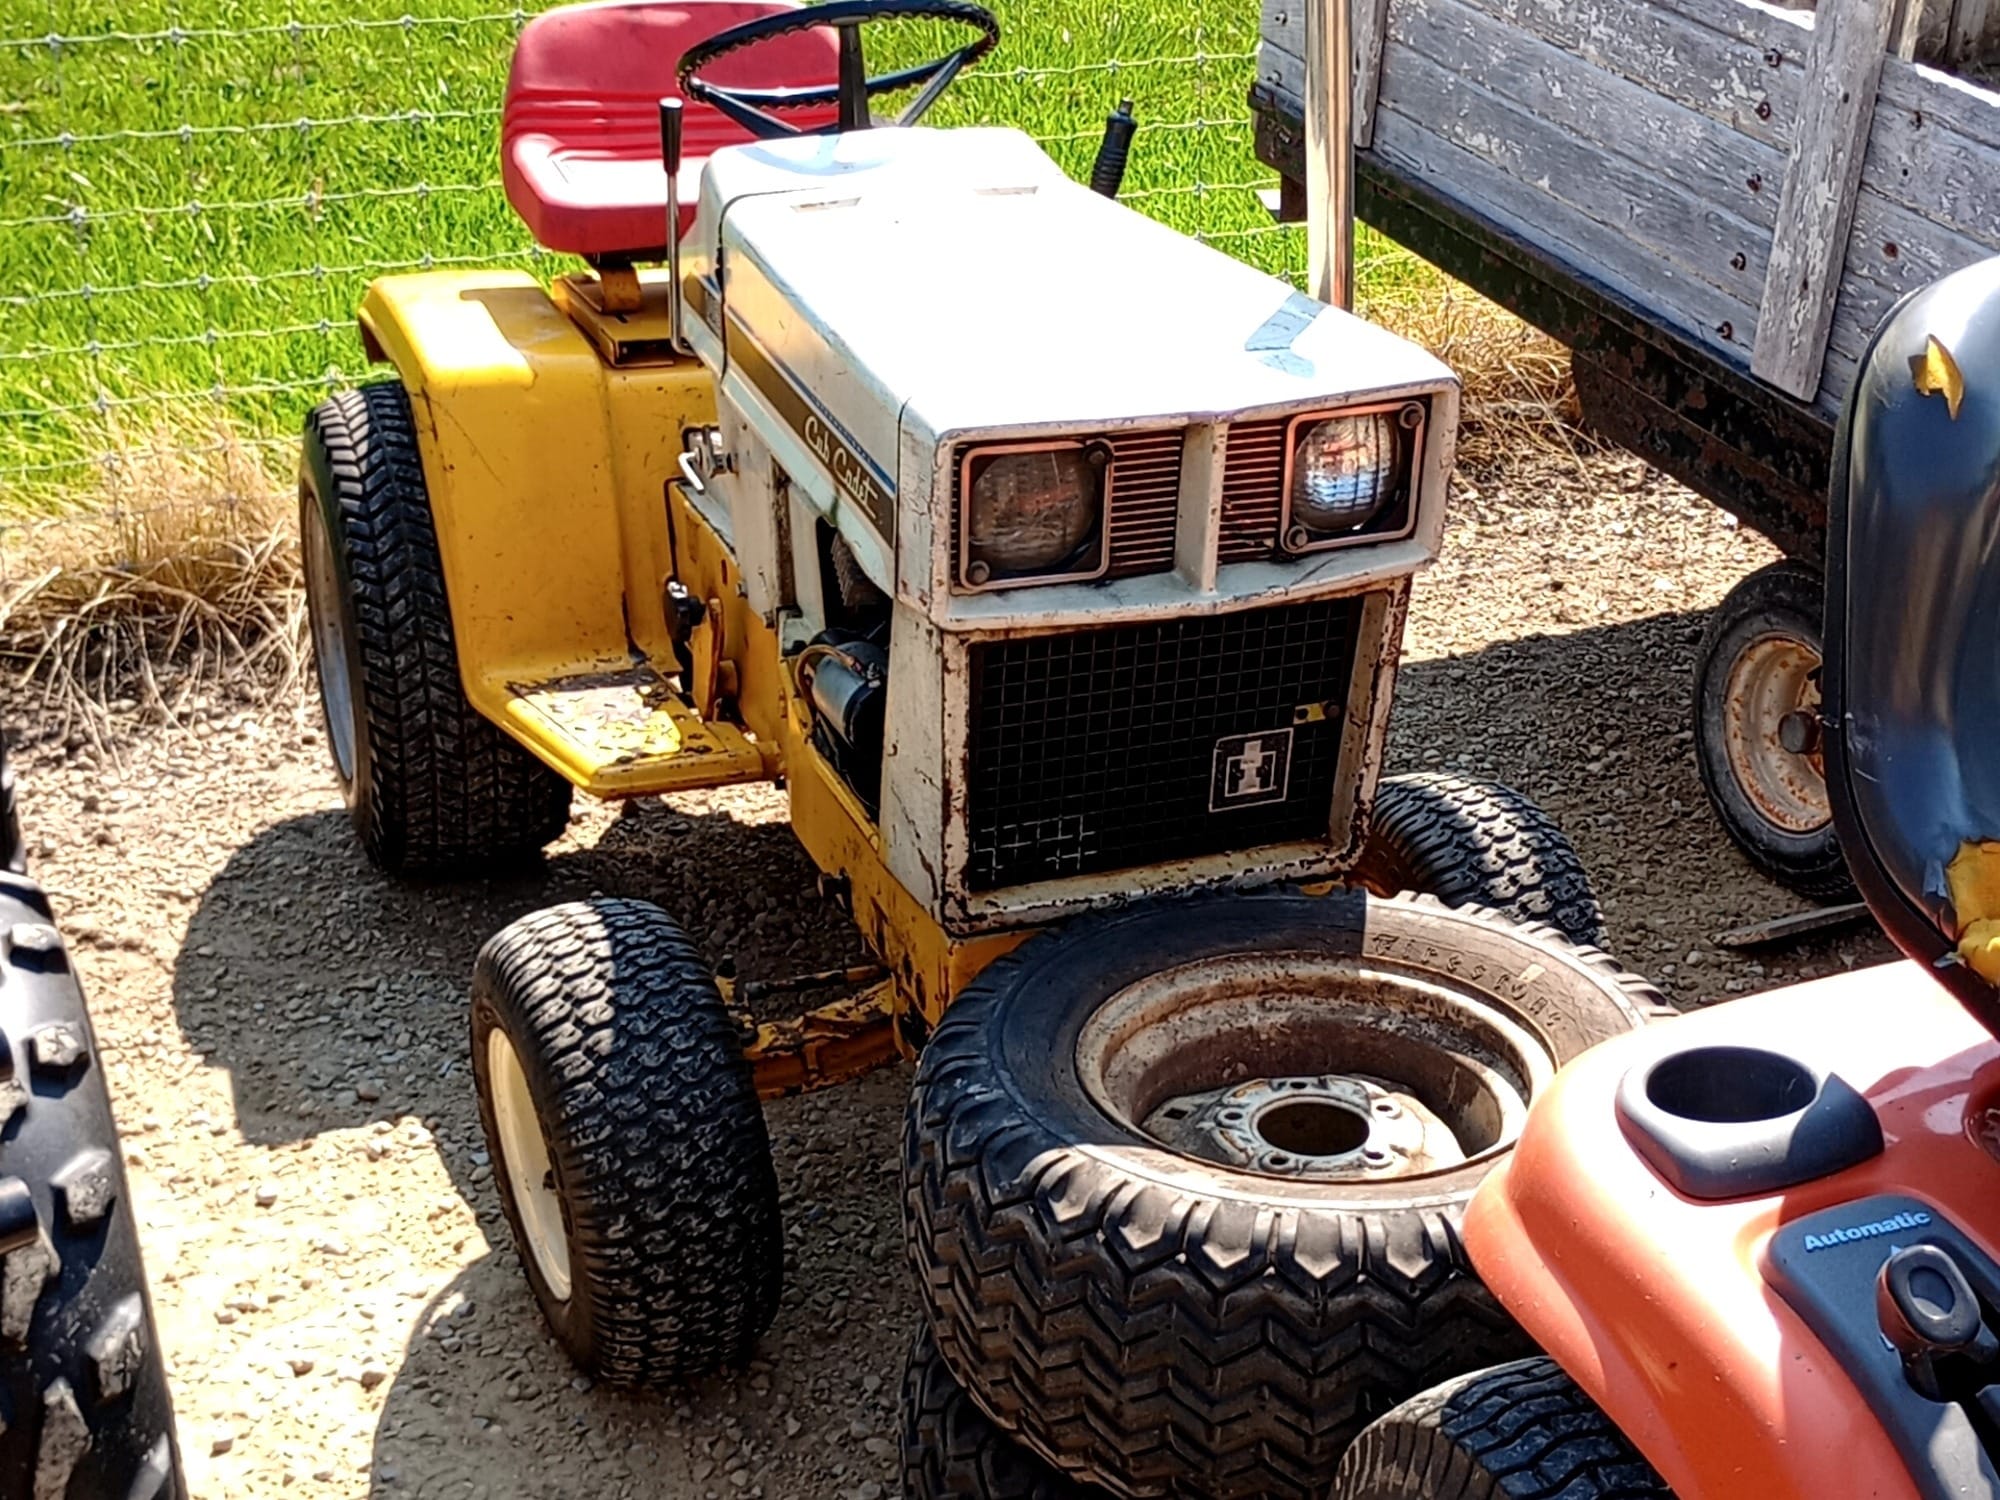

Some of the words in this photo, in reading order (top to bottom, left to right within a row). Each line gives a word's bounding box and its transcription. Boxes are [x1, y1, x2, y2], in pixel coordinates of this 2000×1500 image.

[804, 415, 830, 464] Cub
[833, 447, 878, 519] Cadet
[1804, 1211, 1931, 1251] Automatic
